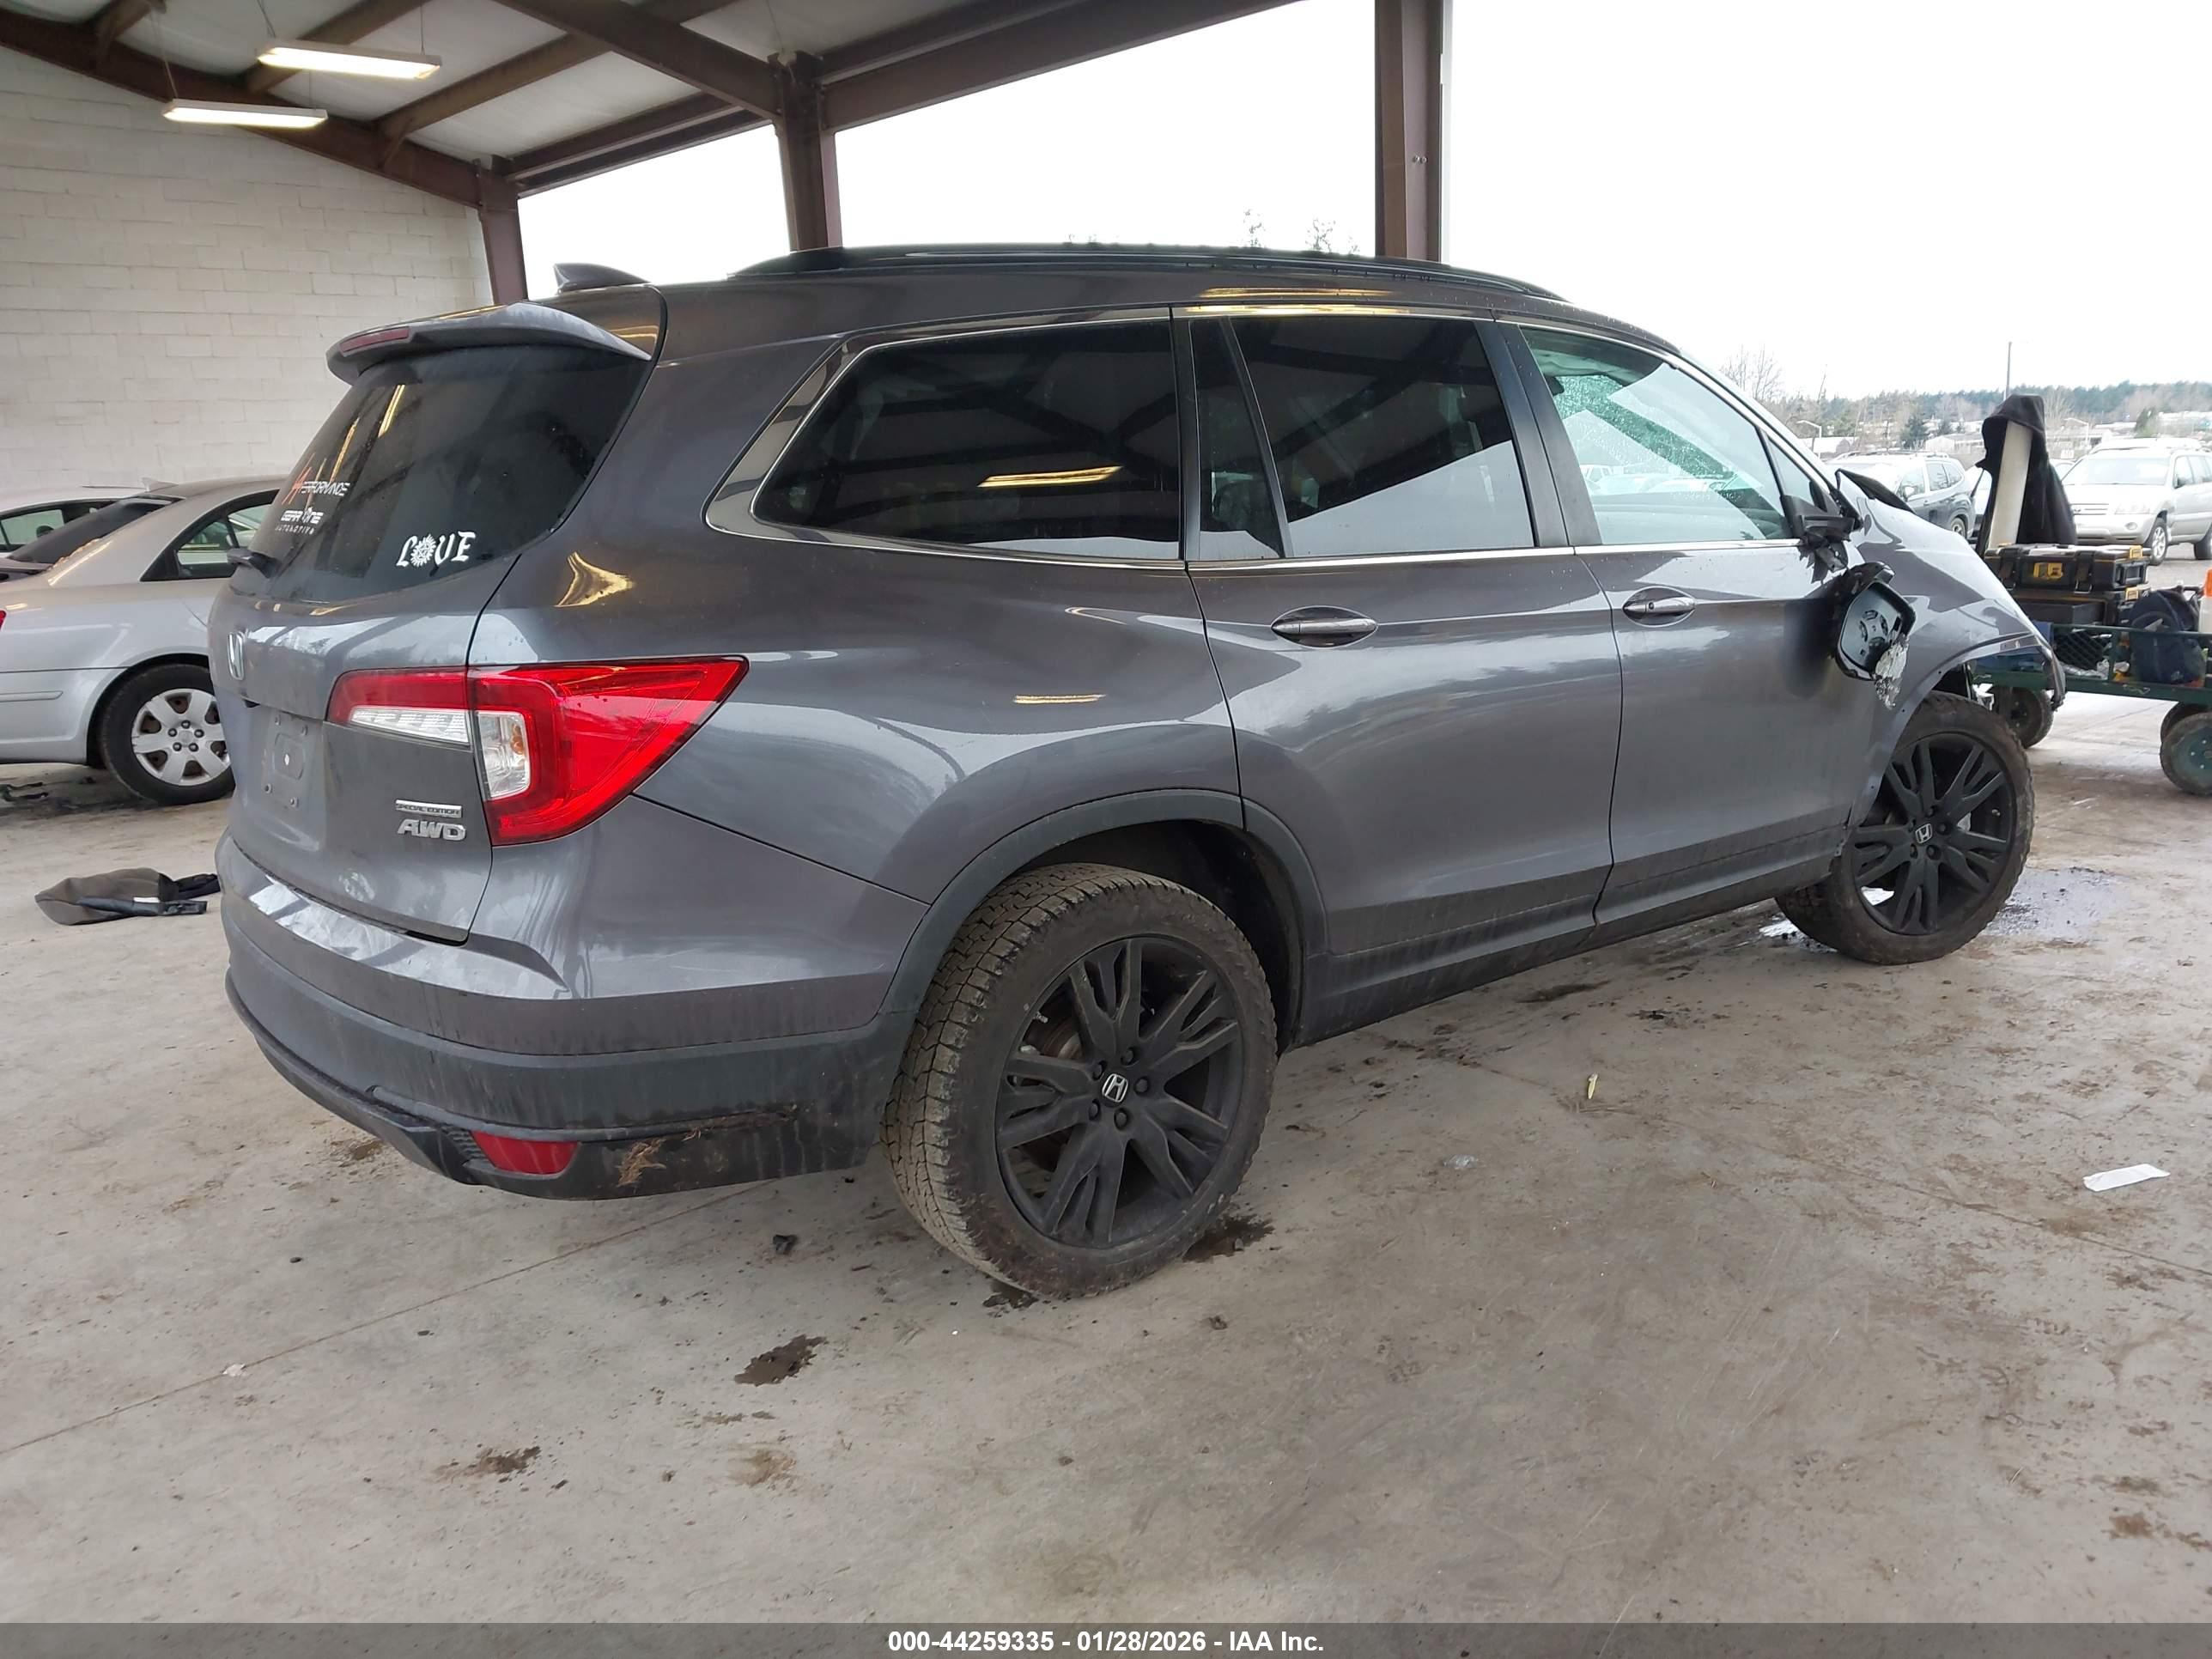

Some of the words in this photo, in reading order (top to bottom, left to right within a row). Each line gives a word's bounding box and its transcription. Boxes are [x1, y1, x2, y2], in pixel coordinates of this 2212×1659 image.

[395, 803, 426, 812] SPECIAL
[427, 807, 460, 816] EDITION
[397, 818, 466, 841] AWD
